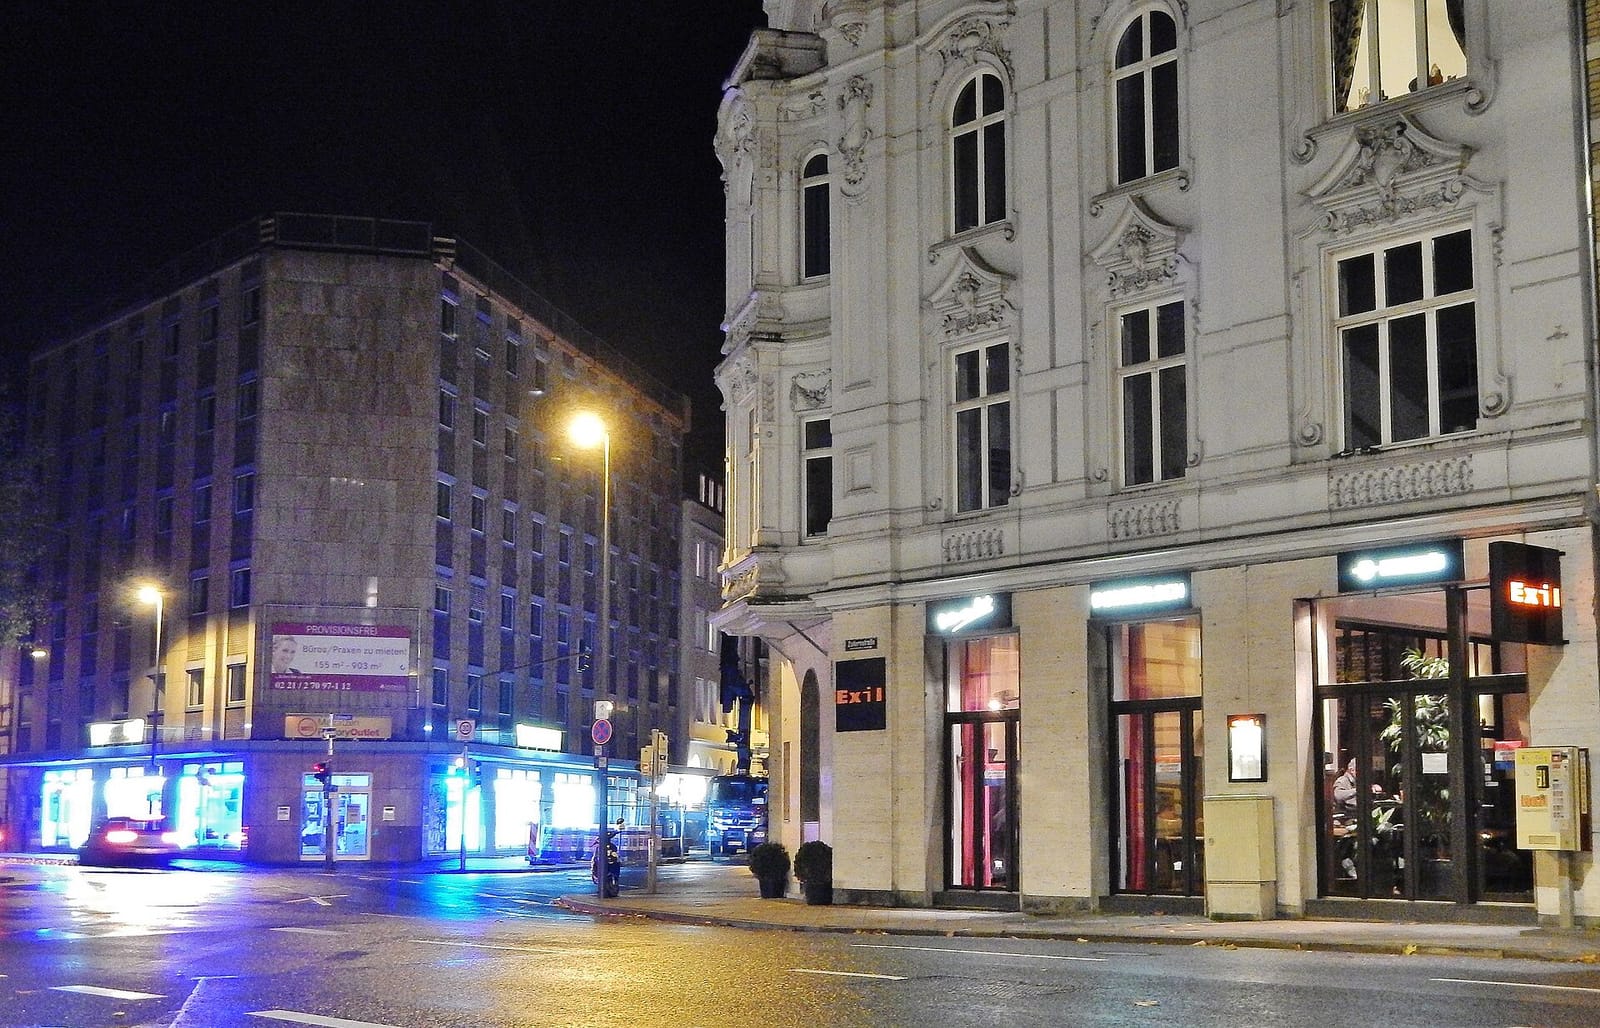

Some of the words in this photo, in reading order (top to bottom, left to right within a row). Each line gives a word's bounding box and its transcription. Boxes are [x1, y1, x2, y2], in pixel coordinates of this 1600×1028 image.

[1510, 581, 1560, 607] Exil
[314, 660, 330, 669] 155
[351, 661, 369, 670] 903
[275, 681, 285, 690] 02
[287, 681, 296, 690] 21
[341, 682, 352, 691] 12
[836, 686, 883, 704] Exil
